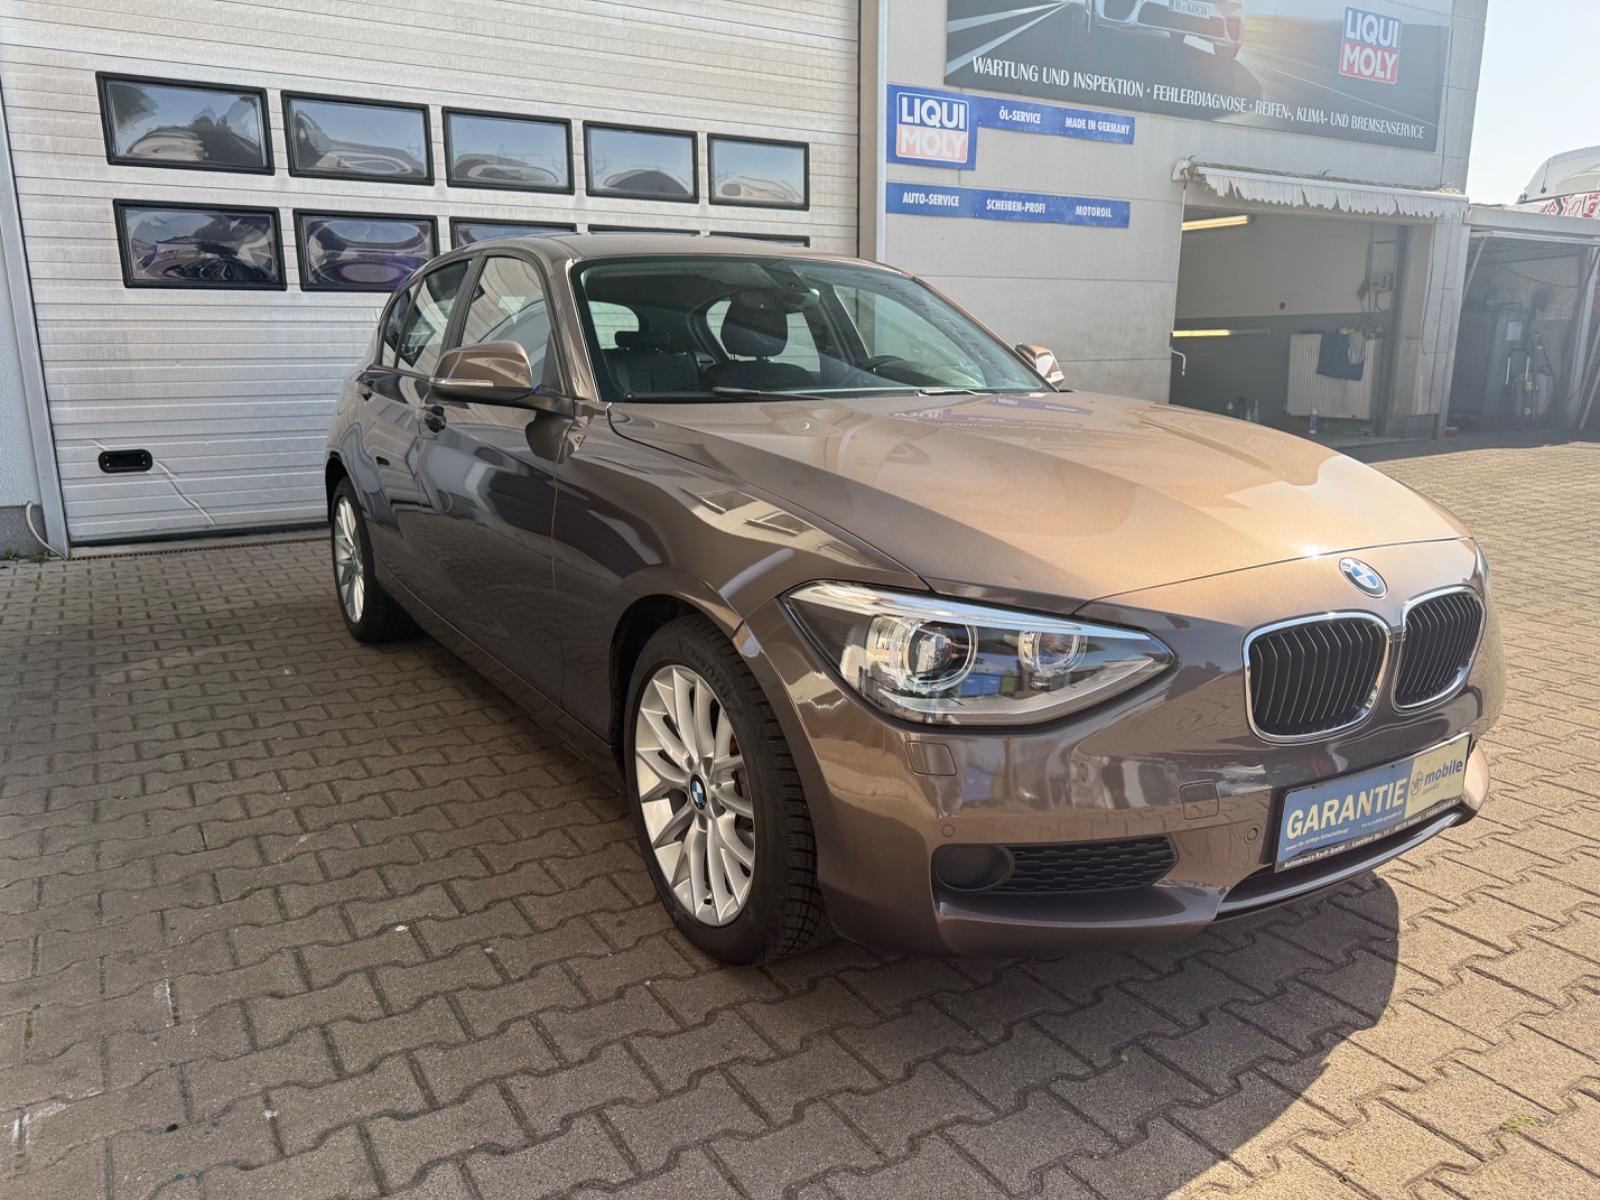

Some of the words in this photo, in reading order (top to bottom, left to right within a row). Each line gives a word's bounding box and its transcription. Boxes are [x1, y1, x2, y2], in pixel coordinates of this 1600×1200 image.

[1345, 12, 1399, 49] LIQUI
[1342, 43, 1398, 80] MOLY
[972, 56, 1039, 82] WARTUNG
[1042, 67, 1070, 86] UND
[1073, 71, 1144, 98] INSPEKTION
[1153, 84, 1247, 113] FEHLERDIAGNOSE
[1255, 100, 1294, 122] REIFEN-,
[1296, 106, 1328, 125] KLIMA-
[1330, 112, 1349, 128] UND
[1351, 114, 1425, 140] BREMSENSERVICE
[901, 96, 966, 130] LIQUI
[999, 106, 1041, 124] ÖL-SERVICE
[1065, 117, 1087, 130] MADE
[1088, 120, 1096, 131] IN
[1097, 121, 1130, 135] GERMANY
[901, 127, 966, 158] MOLY
[902, 191, 959, 207] AUTO-SERVICE
[986, 199, 1045, 215] SCHEIBEN-PROFI
[1075, 205, 1112, 218] MOTOROIL
[1424, 759, 1463, 785] mobile
[1287, 776, 1408, 840] GARANTIE
